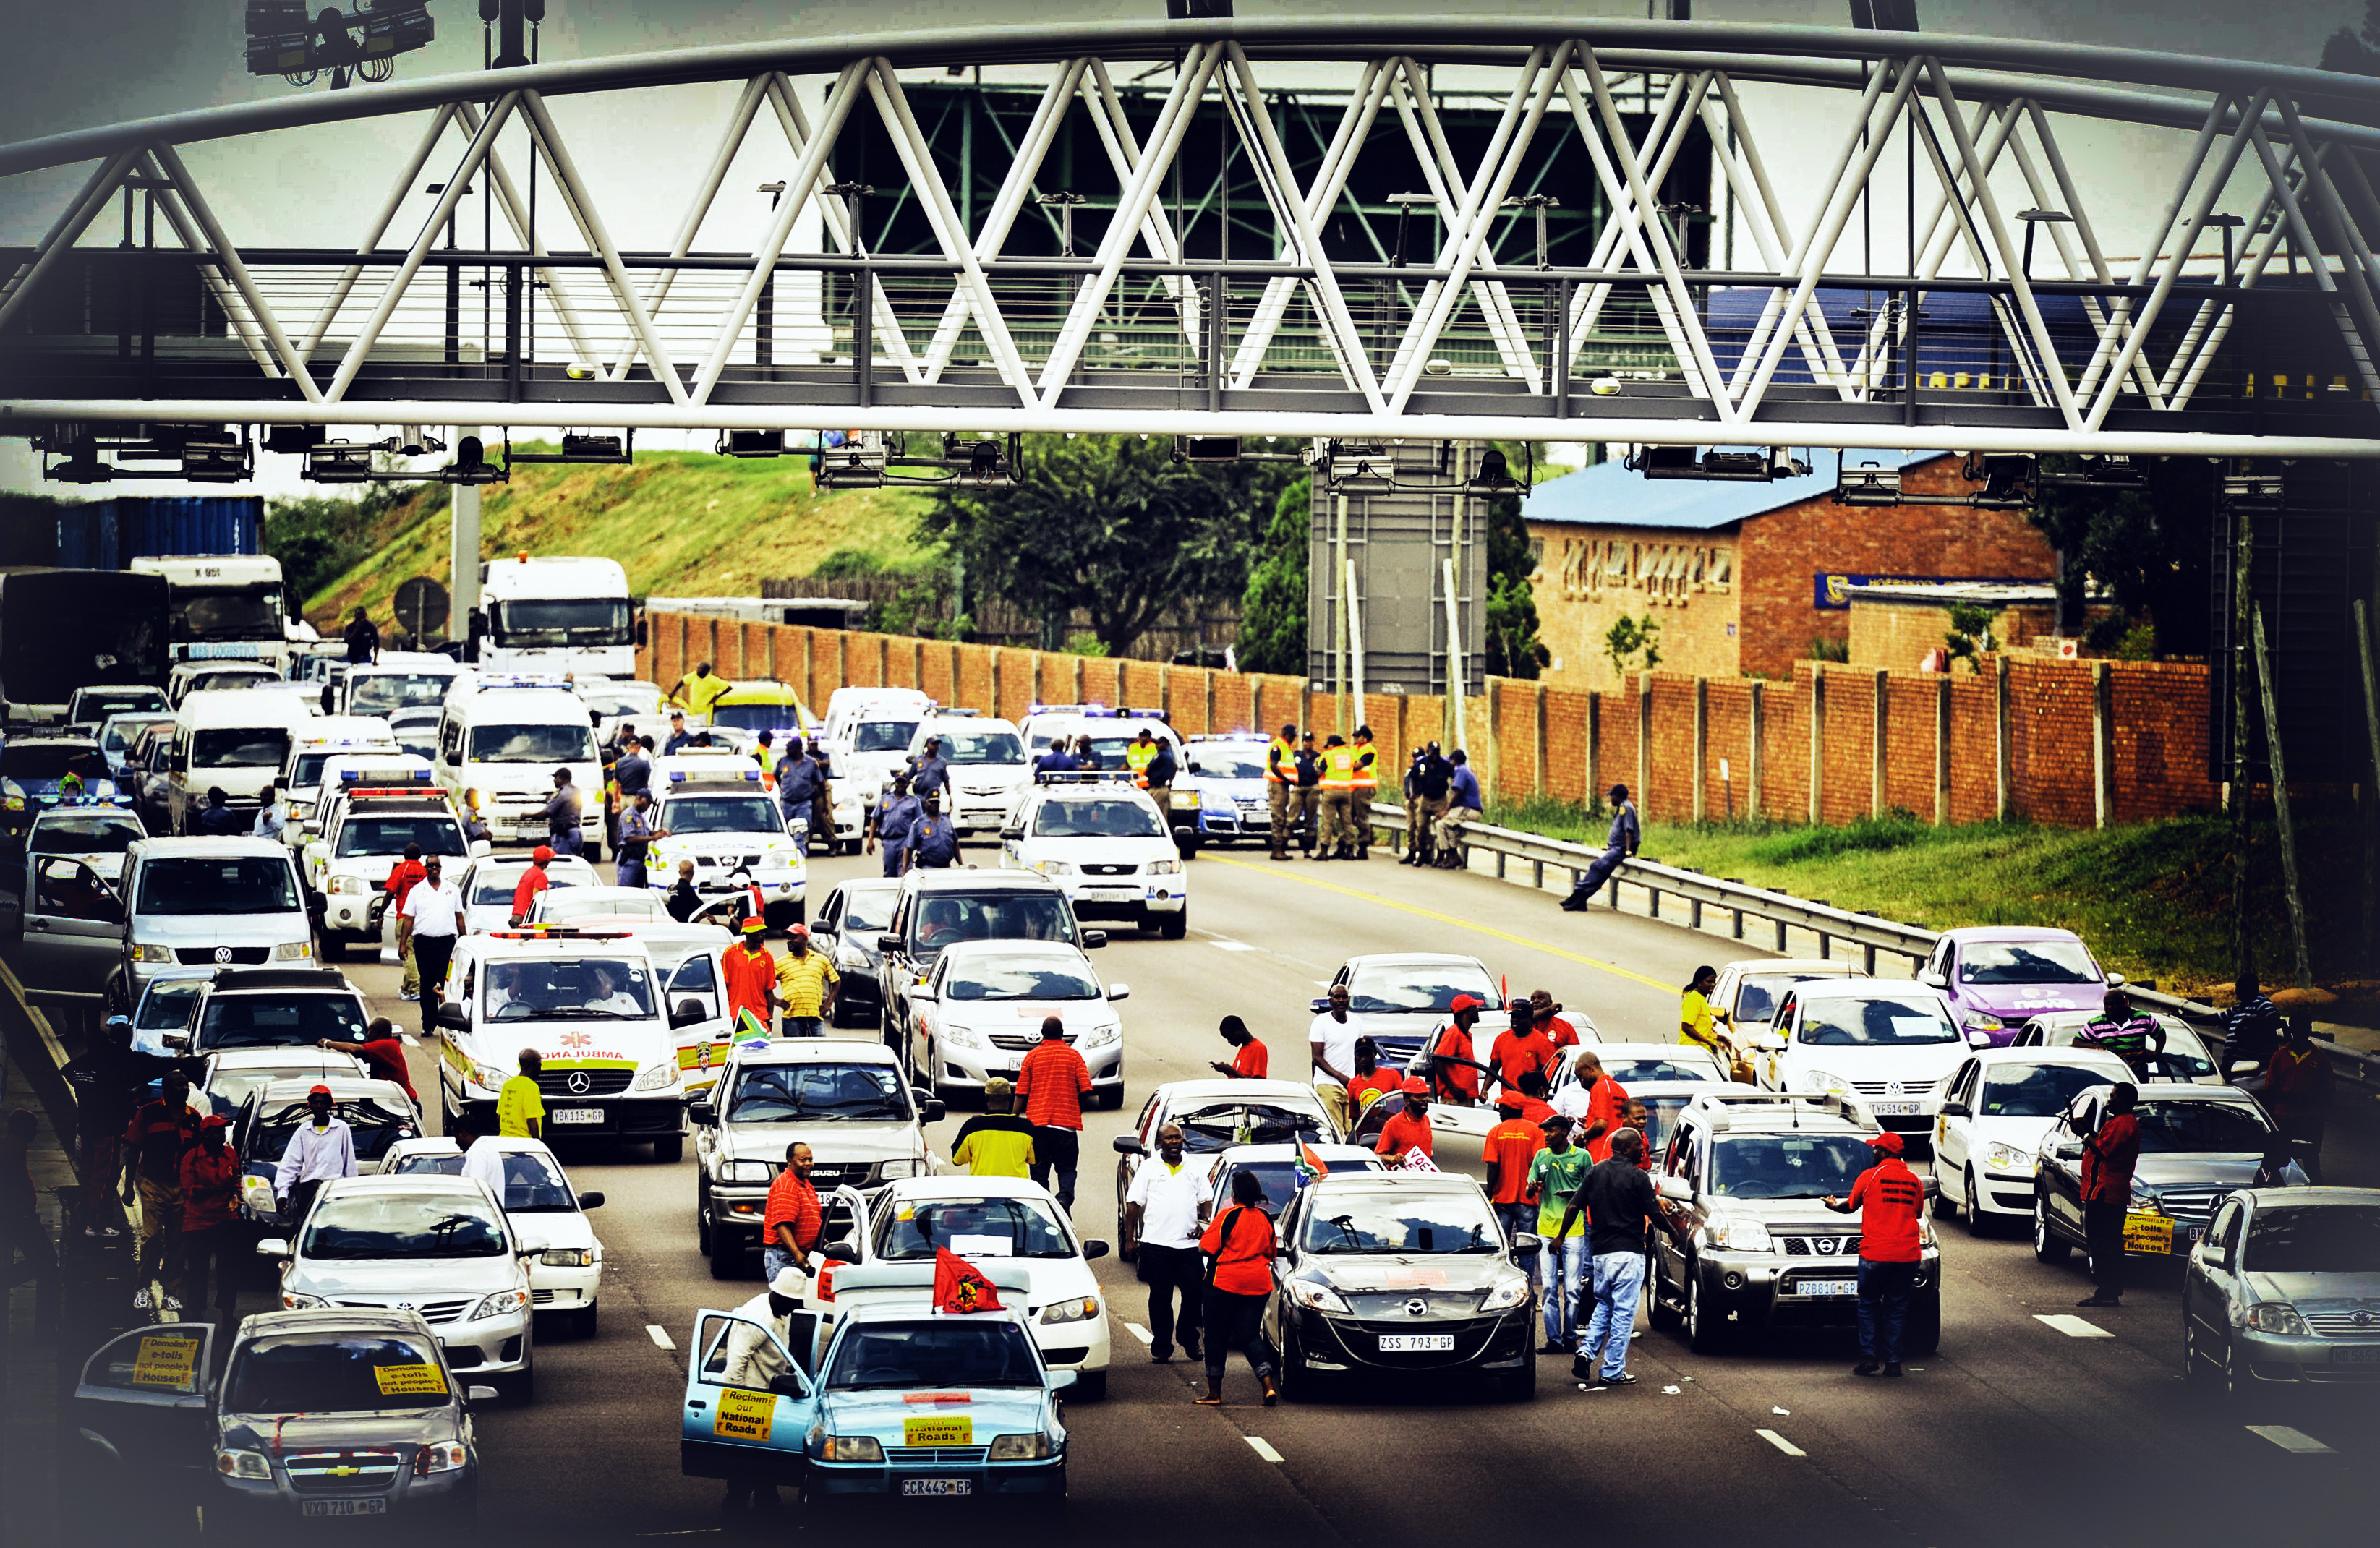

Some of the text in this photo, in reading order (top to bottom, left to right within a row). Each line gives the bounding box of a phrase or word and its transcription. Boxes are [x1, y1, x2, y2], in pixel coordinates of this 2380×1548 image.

[1872, 1104, 1919, 1113] TYF514 GP
[554, 1111, 602, 1121] YBK115 GP
[2128, 1215, 2165, 1224] Demolish
[2131, 1224, 2162, 1233] e-tolls
[2136, 1234, 2170, 1243] people's
[2127, 1241, 2162, 1252] Houses
[1799, 1283, 1856, 1294] PZB810 GP
[150, 1339, 188, 1348] Demolish
[1381, 1336, 1453, 1349] ZSS 793 GP
[152, 1351, 184, 1359] e-tolls
[143, 1372, 181, 1382] Houses
[729, 1390, 769, 1403] Reclaim
[721, 1411, 765, 1424] National
[725, 1422, 757, 1435] Roads
[918, 1432, 956, 1441] Roads
[903, 1480, 971, 1494] CCR443 GP
[330, 1500, 355, 1515] 710
[368, 1499, 383, 1513] GP
